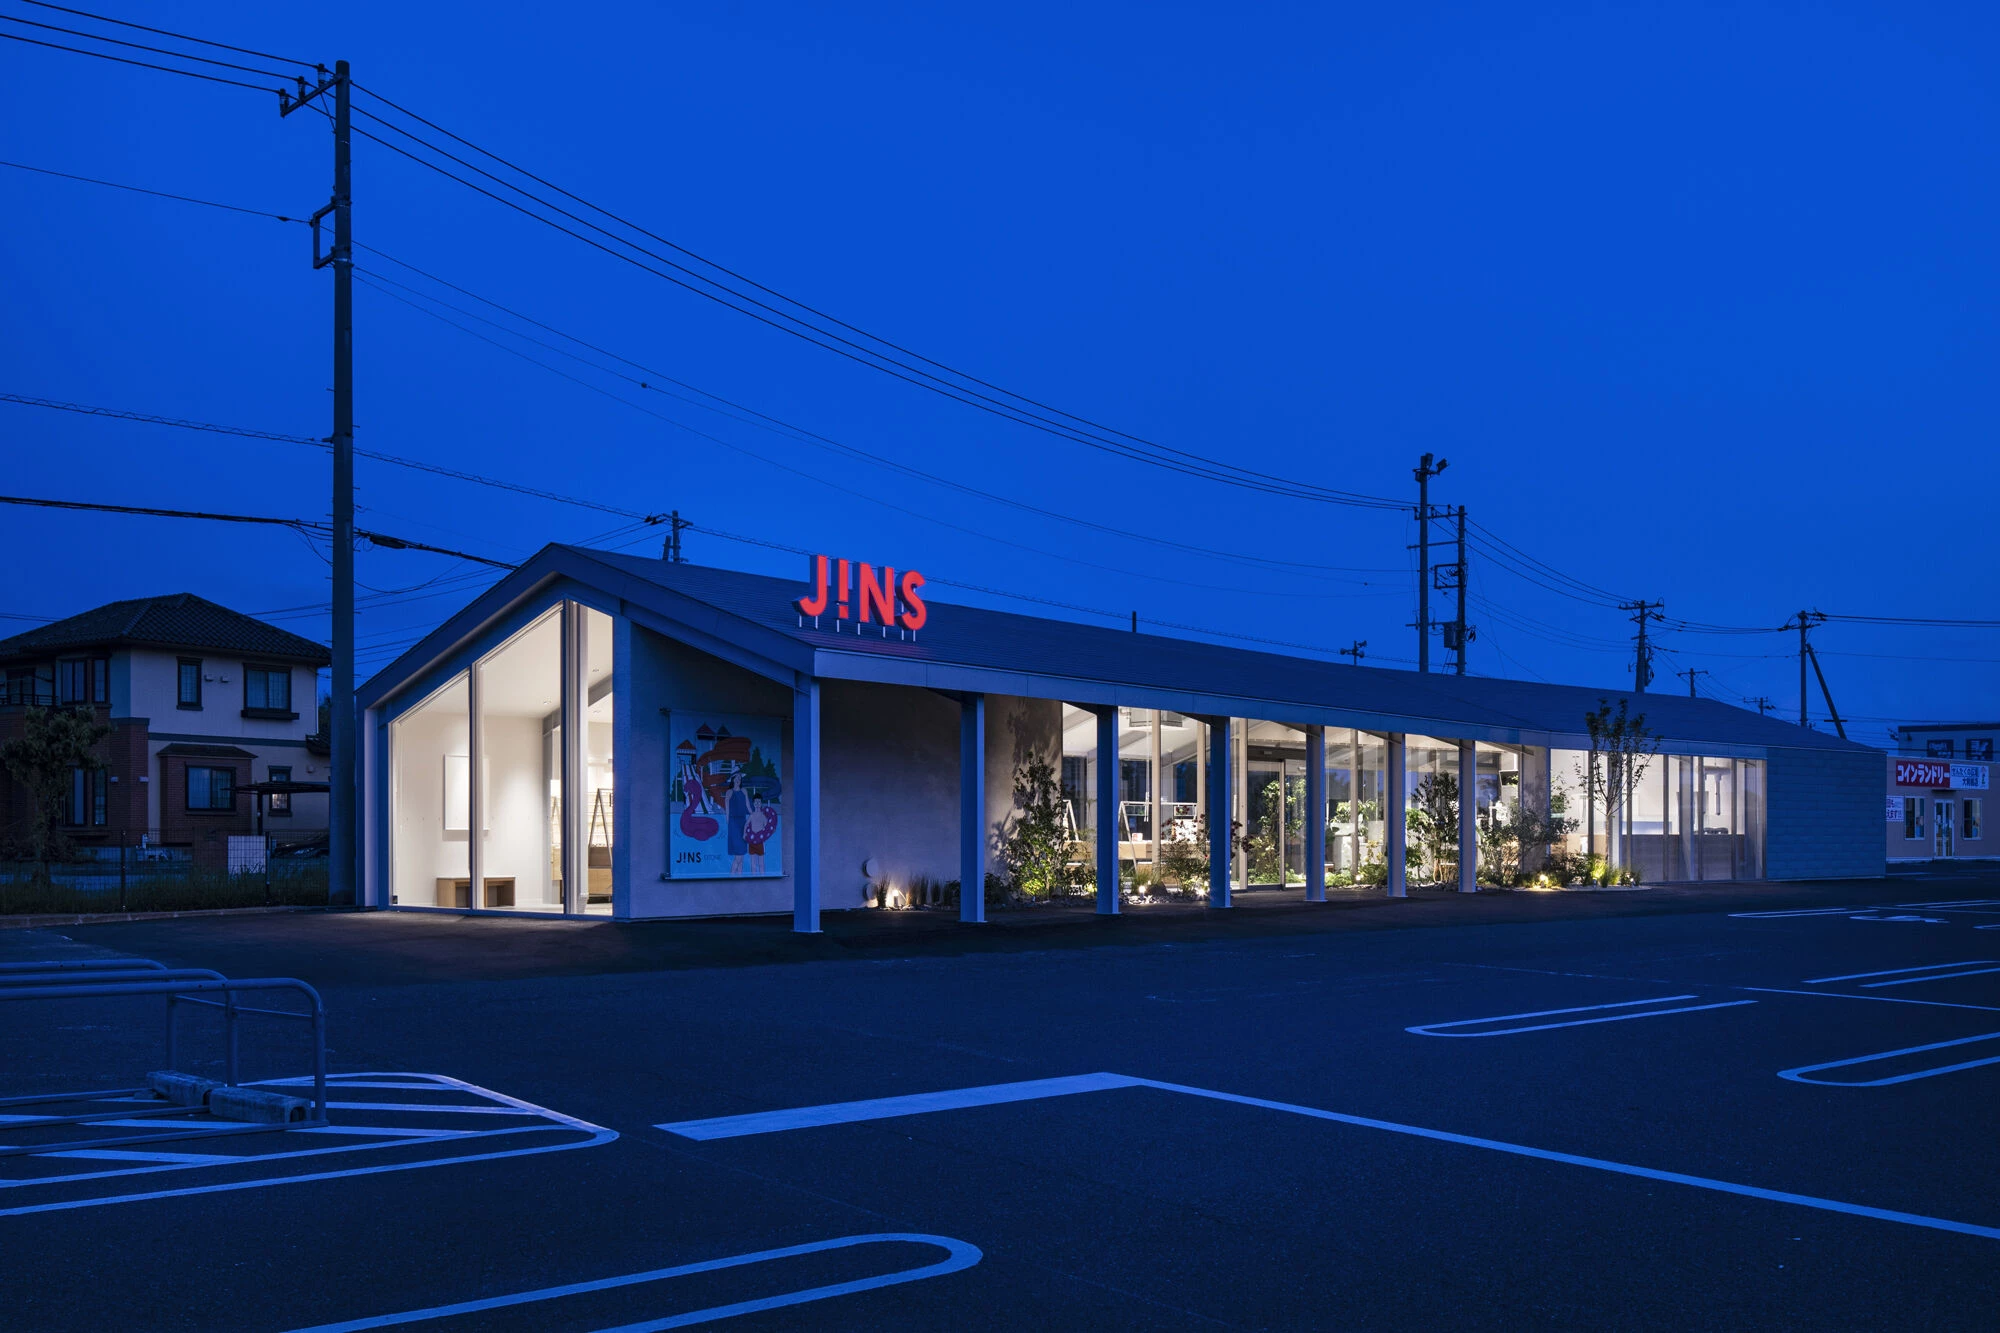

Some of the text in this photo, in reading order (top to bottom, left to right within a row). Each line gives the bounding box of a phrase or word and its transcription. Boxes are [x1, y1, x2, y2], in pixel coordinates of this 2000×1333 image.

[1897, 763, 1950, 784] コインランドリー
